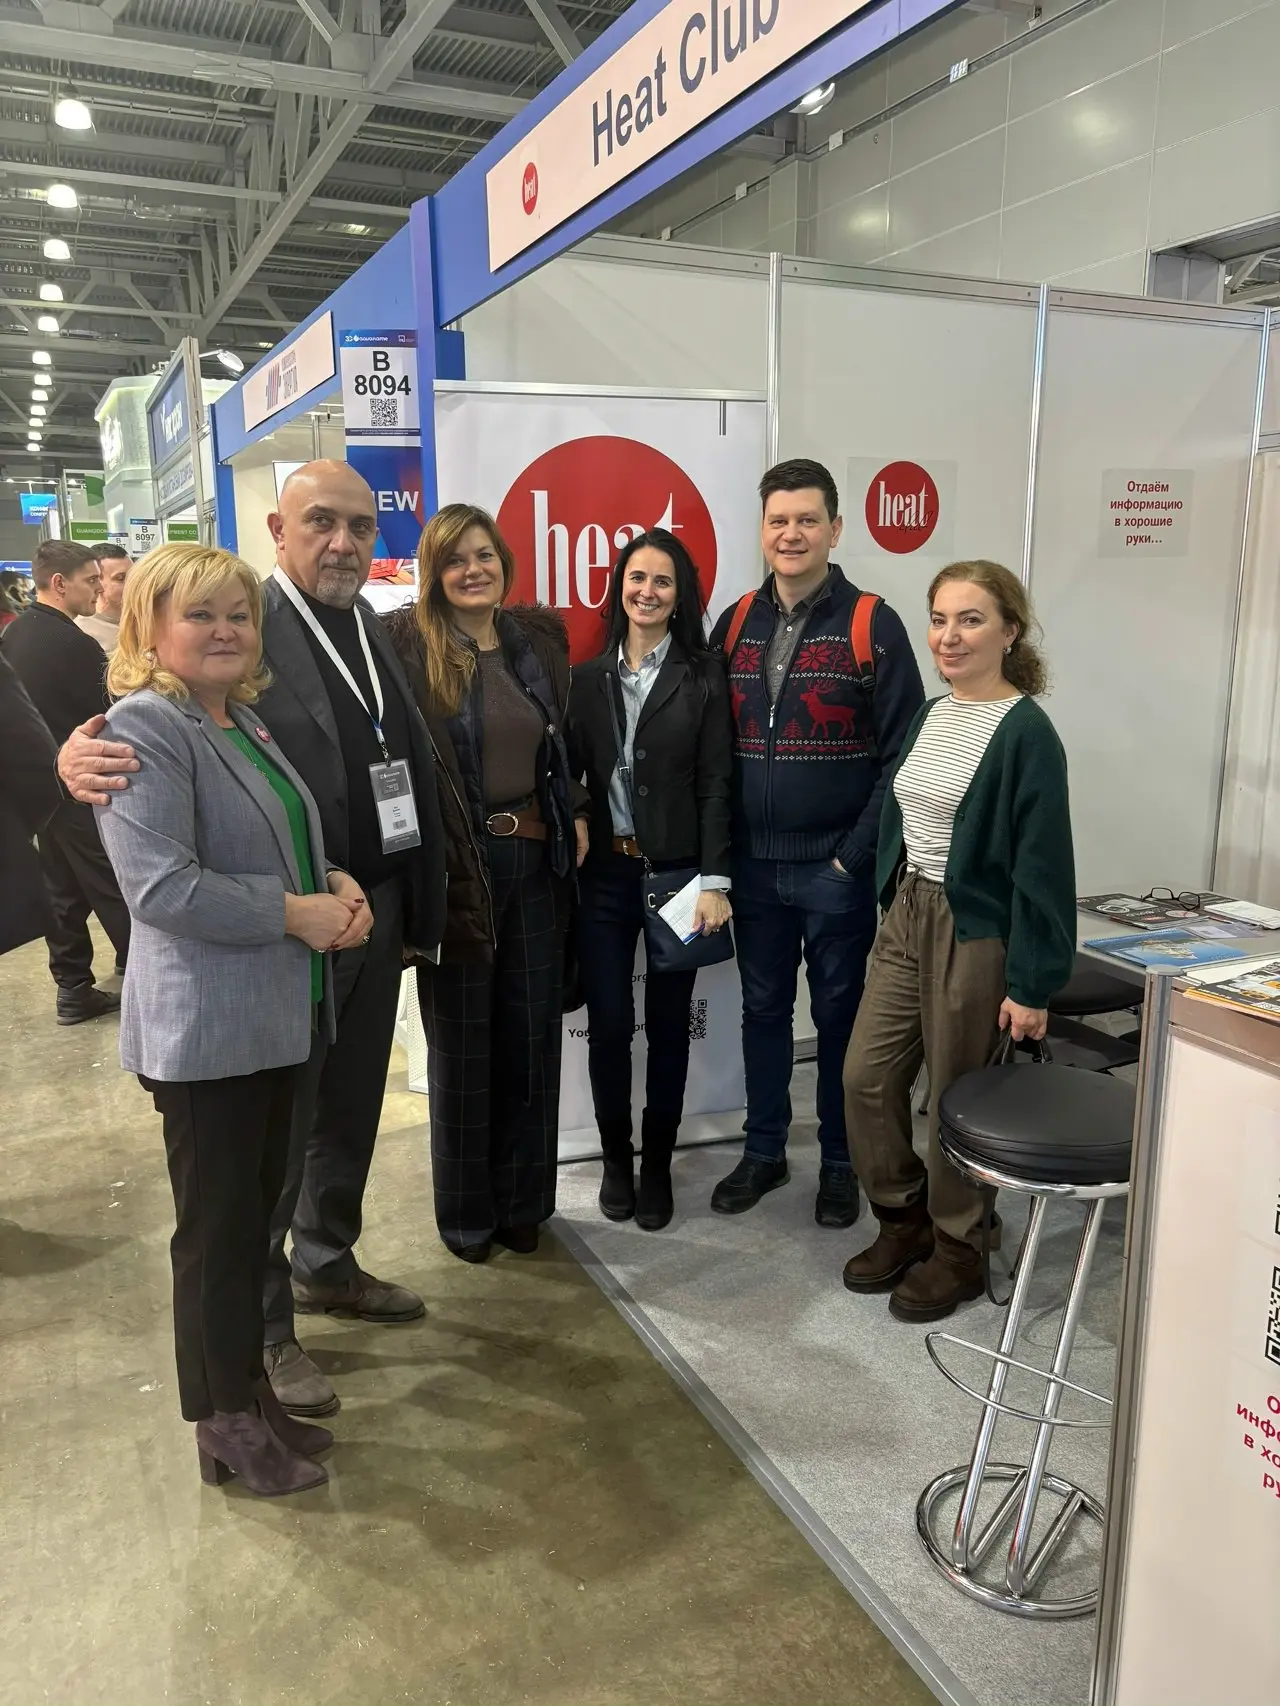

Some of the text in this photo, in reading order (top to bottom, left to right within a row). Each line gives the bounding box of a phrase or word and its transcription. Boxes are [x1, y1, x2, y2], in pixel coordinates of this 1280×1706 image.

[592, 46, 667, 168] Heat
[373, 350, 391, 372] B
[354, 374, 412, 396] 8094
[1127, 480, 1169, 493] Отдаём
[371, 490, 419, 512] EW
[878, 480, 929, 527] heat
[1110, 498, 1183, 512] информацию
[1114, 517, 1173, 529] в хорошие
[135, 533, 155, 541] 8097
[530, 489, 684, 609] he
